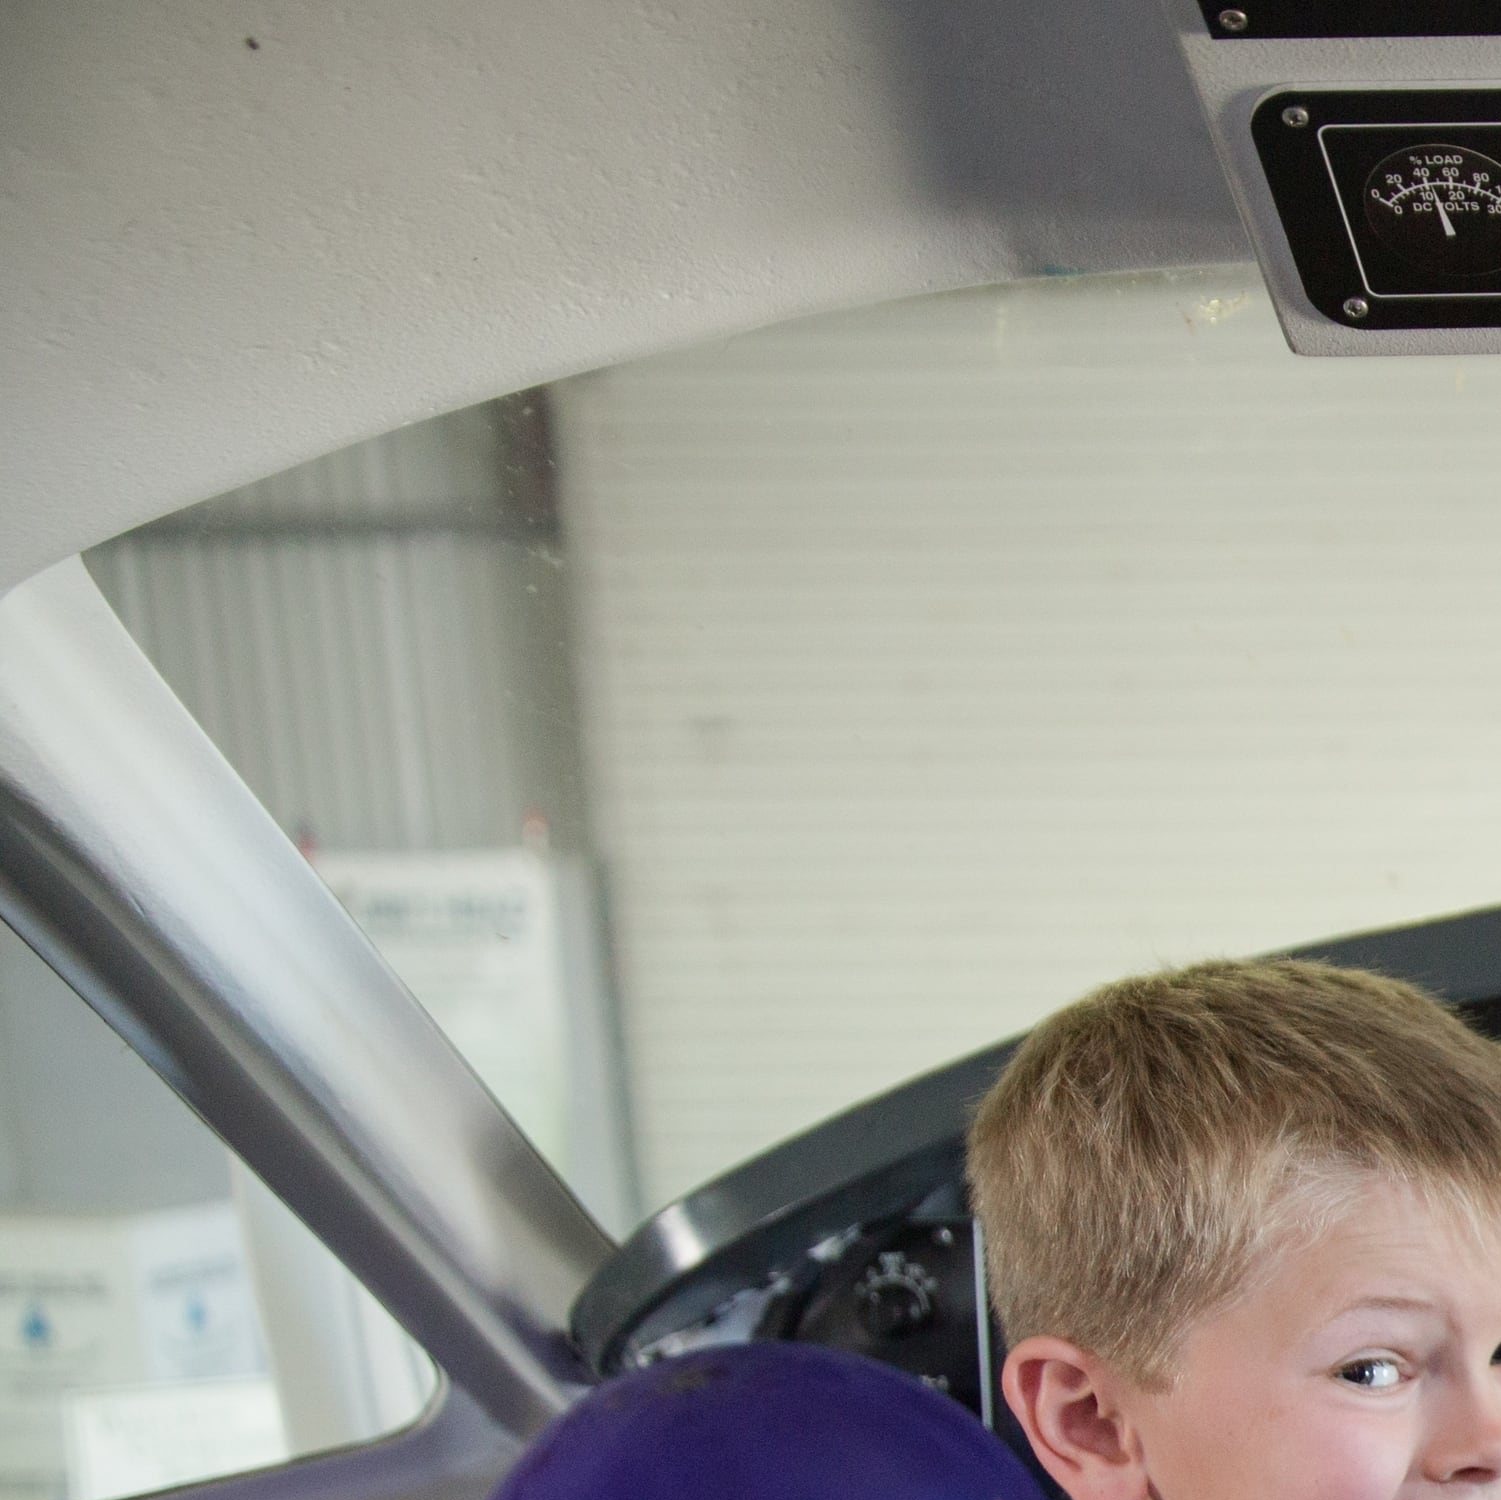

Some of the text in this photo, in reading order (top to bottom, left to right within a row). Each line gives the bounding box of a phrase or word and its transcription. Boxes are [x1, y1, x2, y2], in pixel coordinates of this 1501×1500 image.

[1409, 154, 1463, 166] % LOAD
[1413, 167, 1430, 177] 40
[1442, 167, 1459, 177] 60
[1385, 174, 1402, 184] 20
[1473, 173, 1489, 183] 80
[1371, 188, 1380, 199] 0
[1420, 191, 1434, 201] 10
[1448, 191, 1465, 201] 20
[1394, 205, 1403, 215] 0
[1413, 202, 1433, 212] DC
